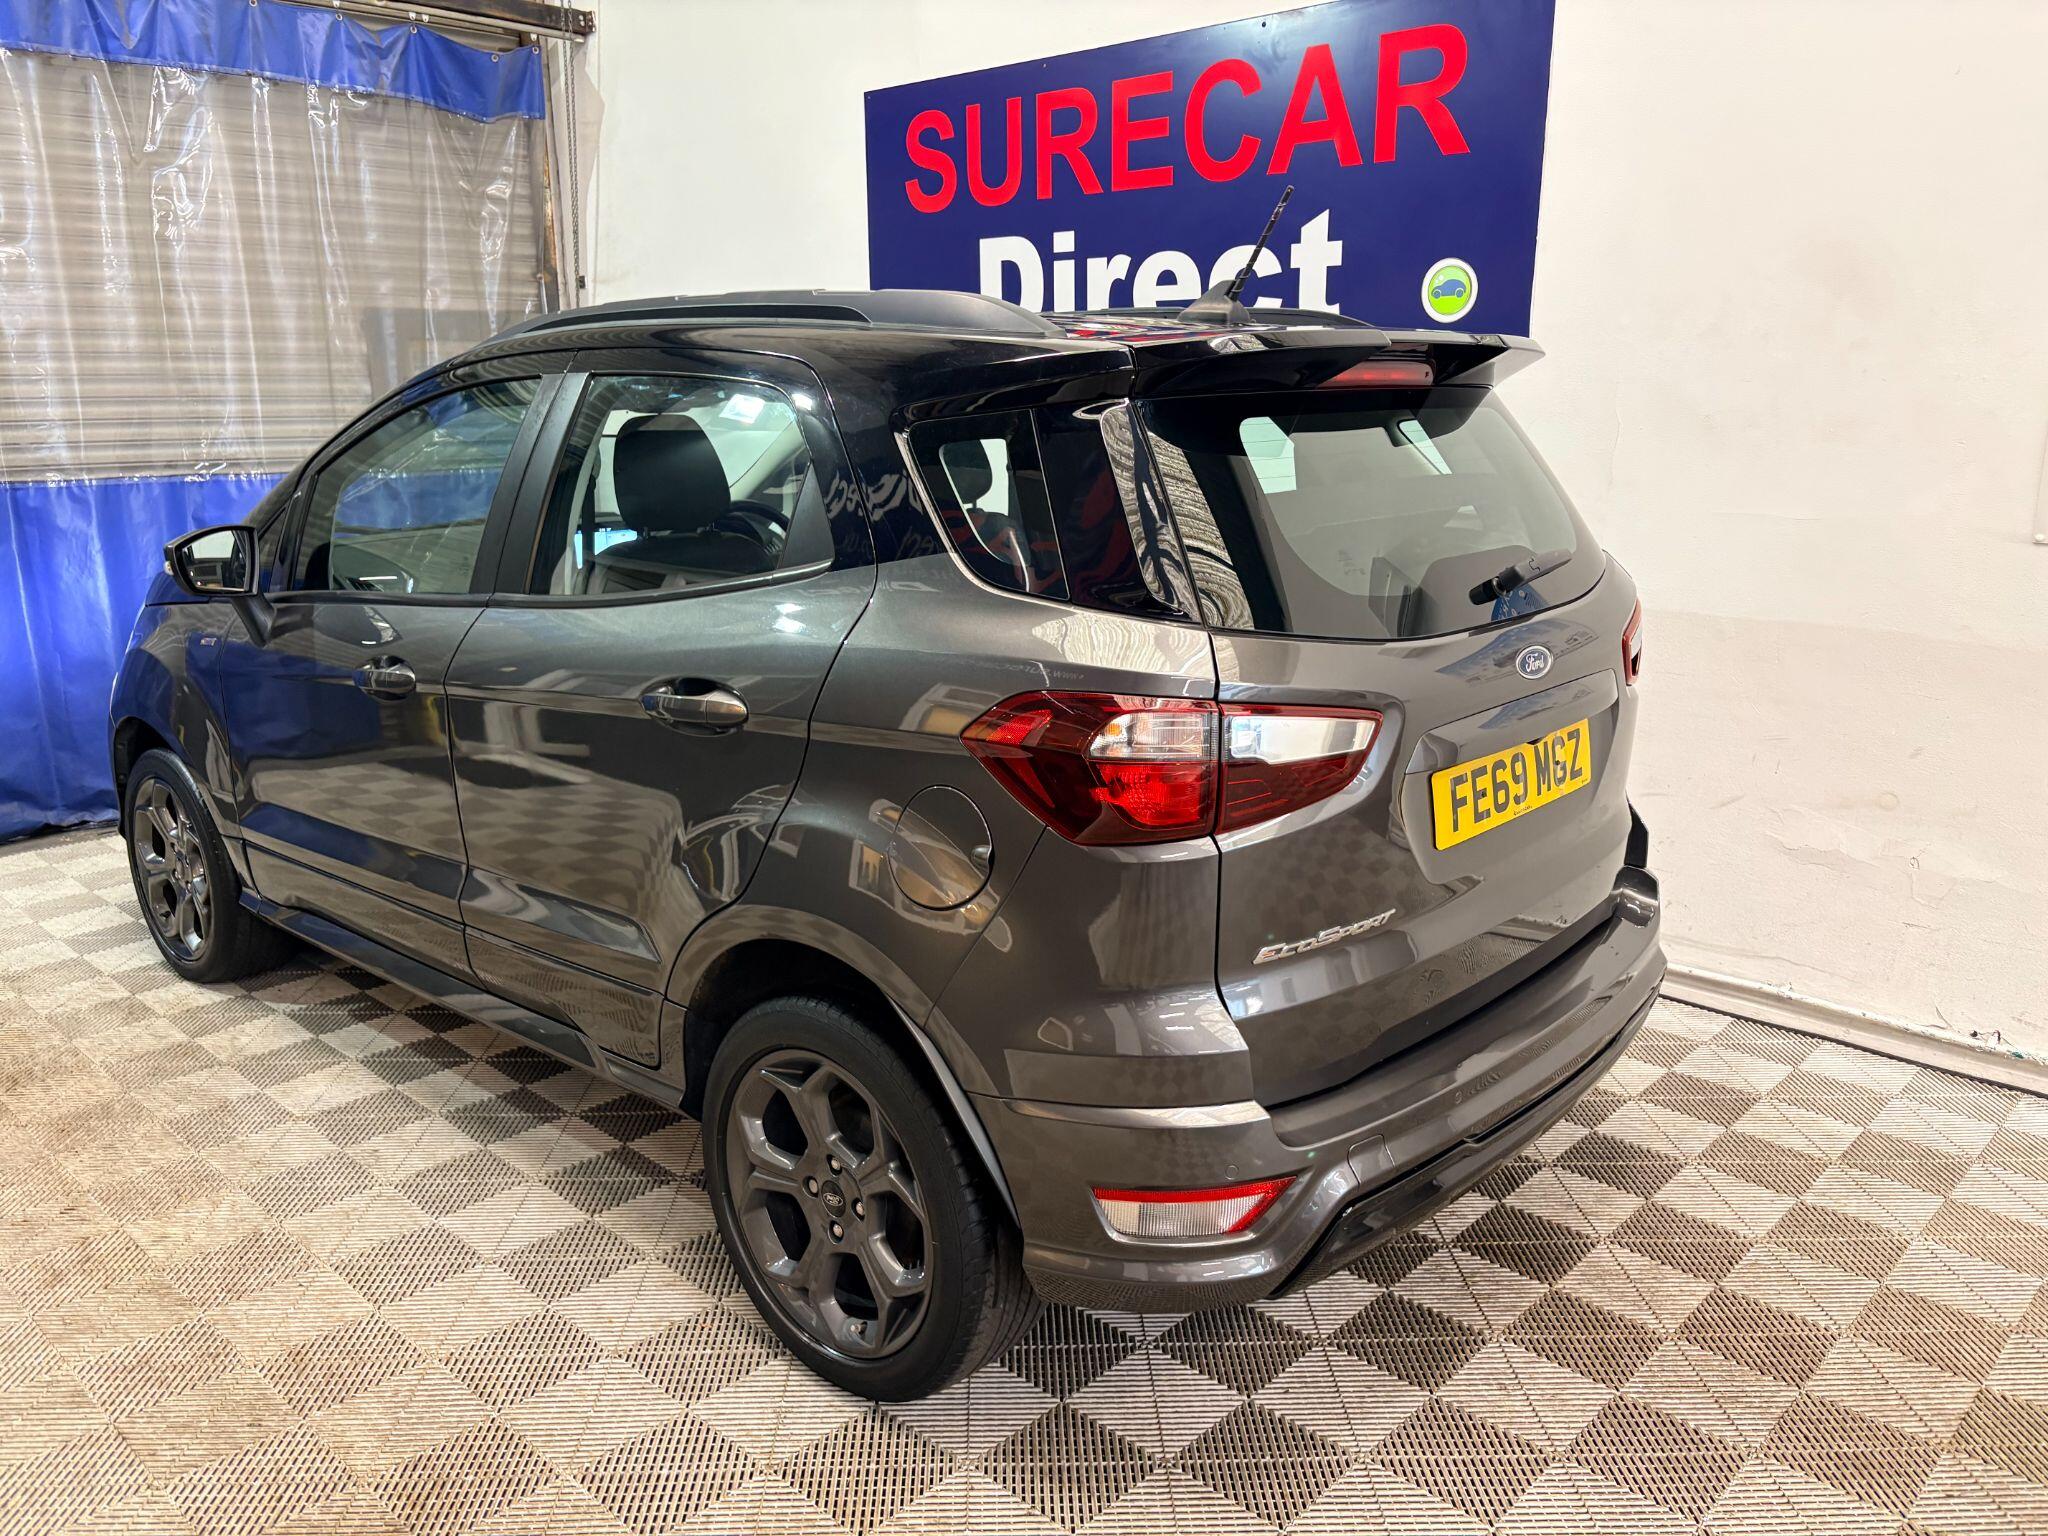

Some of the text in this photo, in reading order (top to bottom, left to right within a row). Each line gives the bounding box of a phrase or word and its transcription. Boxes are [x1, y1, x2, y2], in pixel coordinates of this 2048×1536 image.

[905, 24, 1470, 213] SURECAR
[1525, 652, 1545, 673] Ford
[1450, 727, 1583, 832] FE69 MGZ
